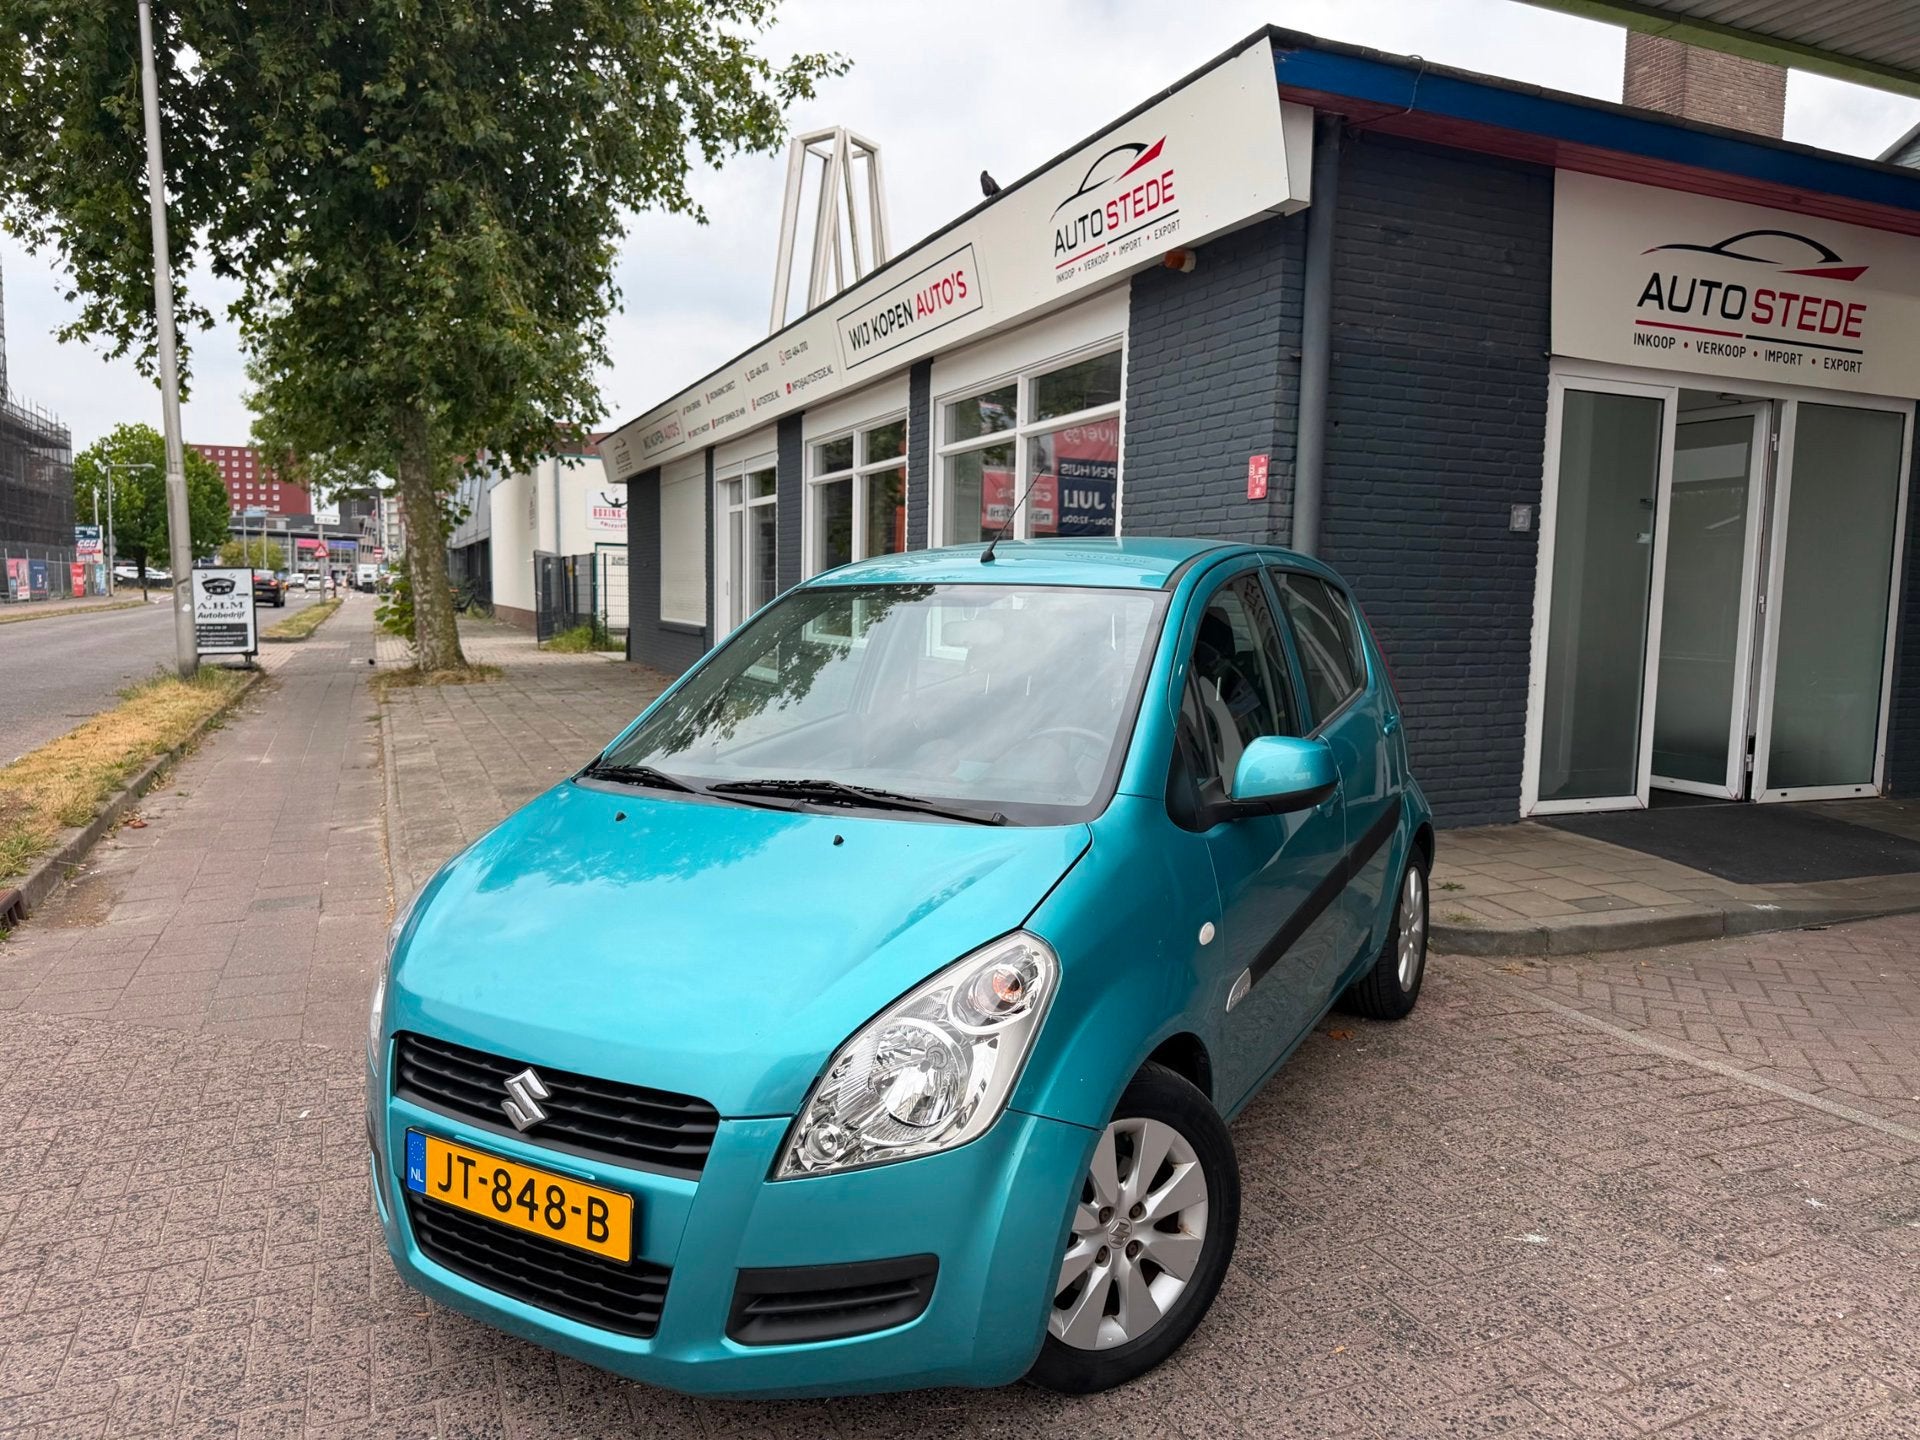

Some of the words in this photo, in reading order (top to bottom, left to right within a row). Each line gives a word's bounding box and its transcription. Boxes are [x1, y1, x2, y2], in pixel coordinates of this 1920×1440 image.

[1054, 169, 1175, 258] AUTOSTEDE
[1056, 267, 1075, 284] INKOOP
[1083, 251, 1110, 272] VERKOOP
[1118, 236, 1142, 256] IMPORT
[1153, 219, 1181, 240] EXPORT
[848, 321, 871, 351] WIJ
[870, 298, 914, 342] KOPEN
[916, 270, 967, 320] AUTO'S
[1637, 272, 1867, 338] AUTOSTEDE
[1633, 332, 1676, 349] INKOOP
[1696, 340, 1747, 359] VERKOOP
[1764, 349, 1803, 366] IMPORT
[1823, 357, 1863, 374] EXPORT
[198, 611, 246, 620] Autobedrijf
[410, 1167, 424, 1184] NL
[437, 1152, 609, 1244] JT-848-B
